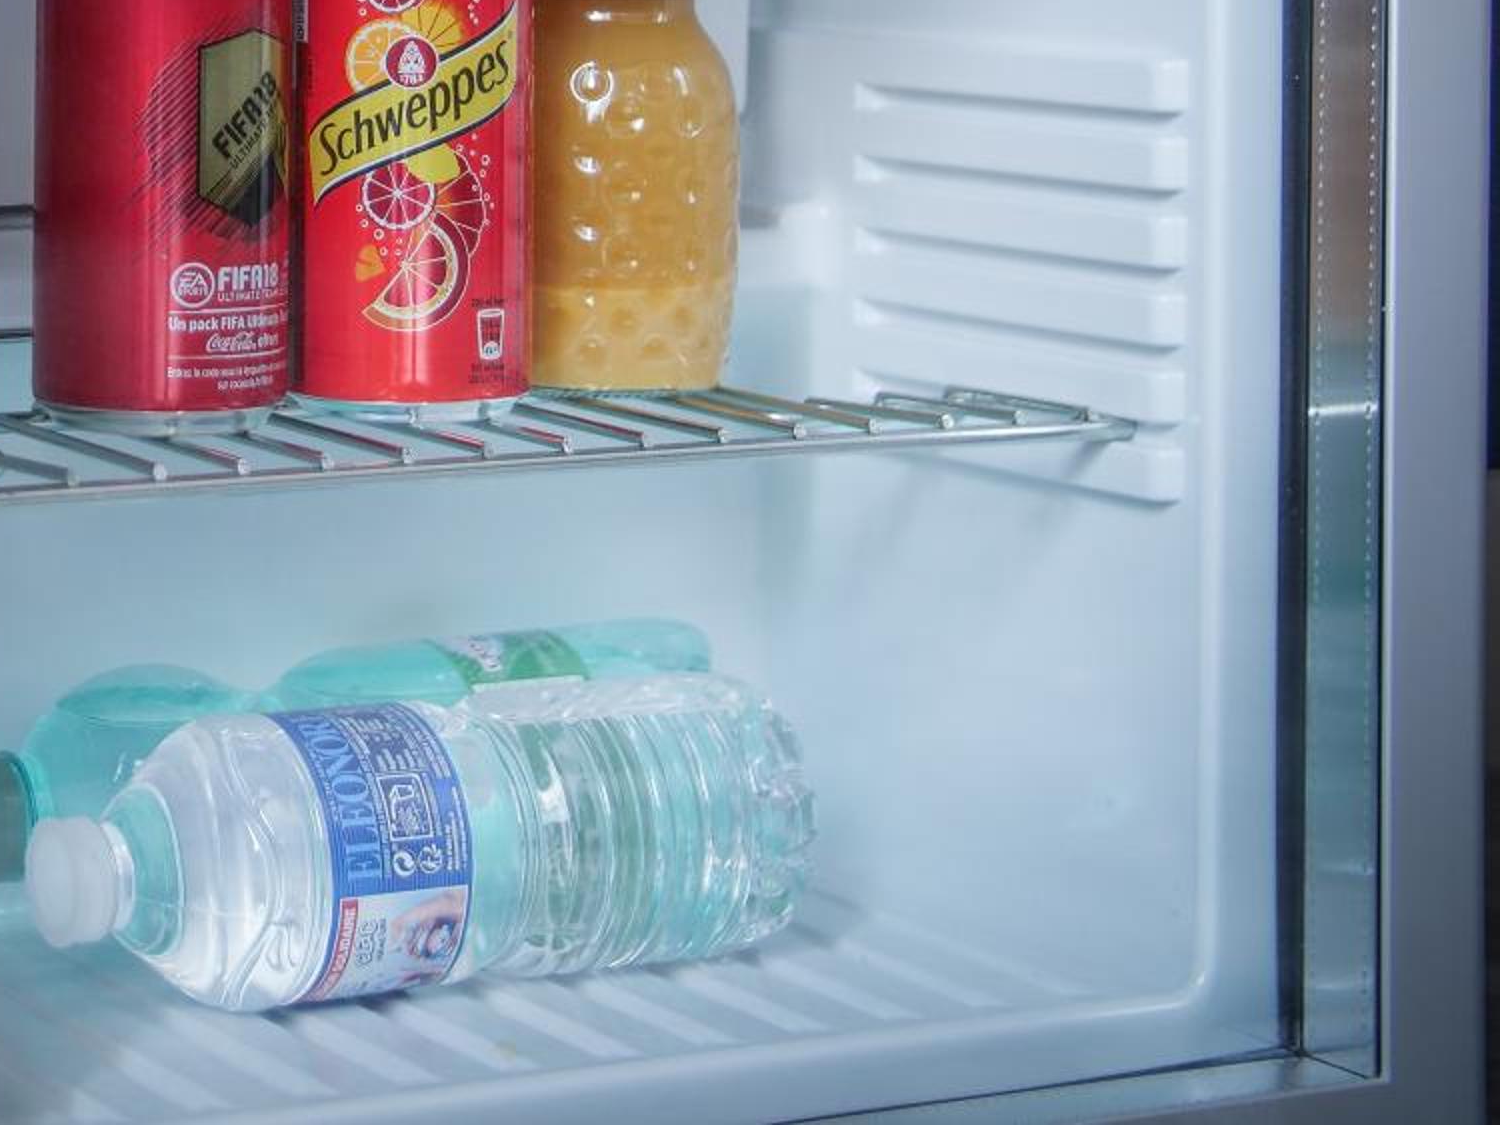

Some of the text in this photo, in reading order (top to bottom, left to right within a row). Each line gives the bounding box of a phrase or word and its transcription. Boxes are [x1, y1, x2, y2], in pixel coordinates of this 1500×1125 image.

[320, 39, 509, 175] Schweppes
[169, 316, 187, 331] Un
[189, 316, 219, 333] pack
[221, 315, 246, 330] FIFA
